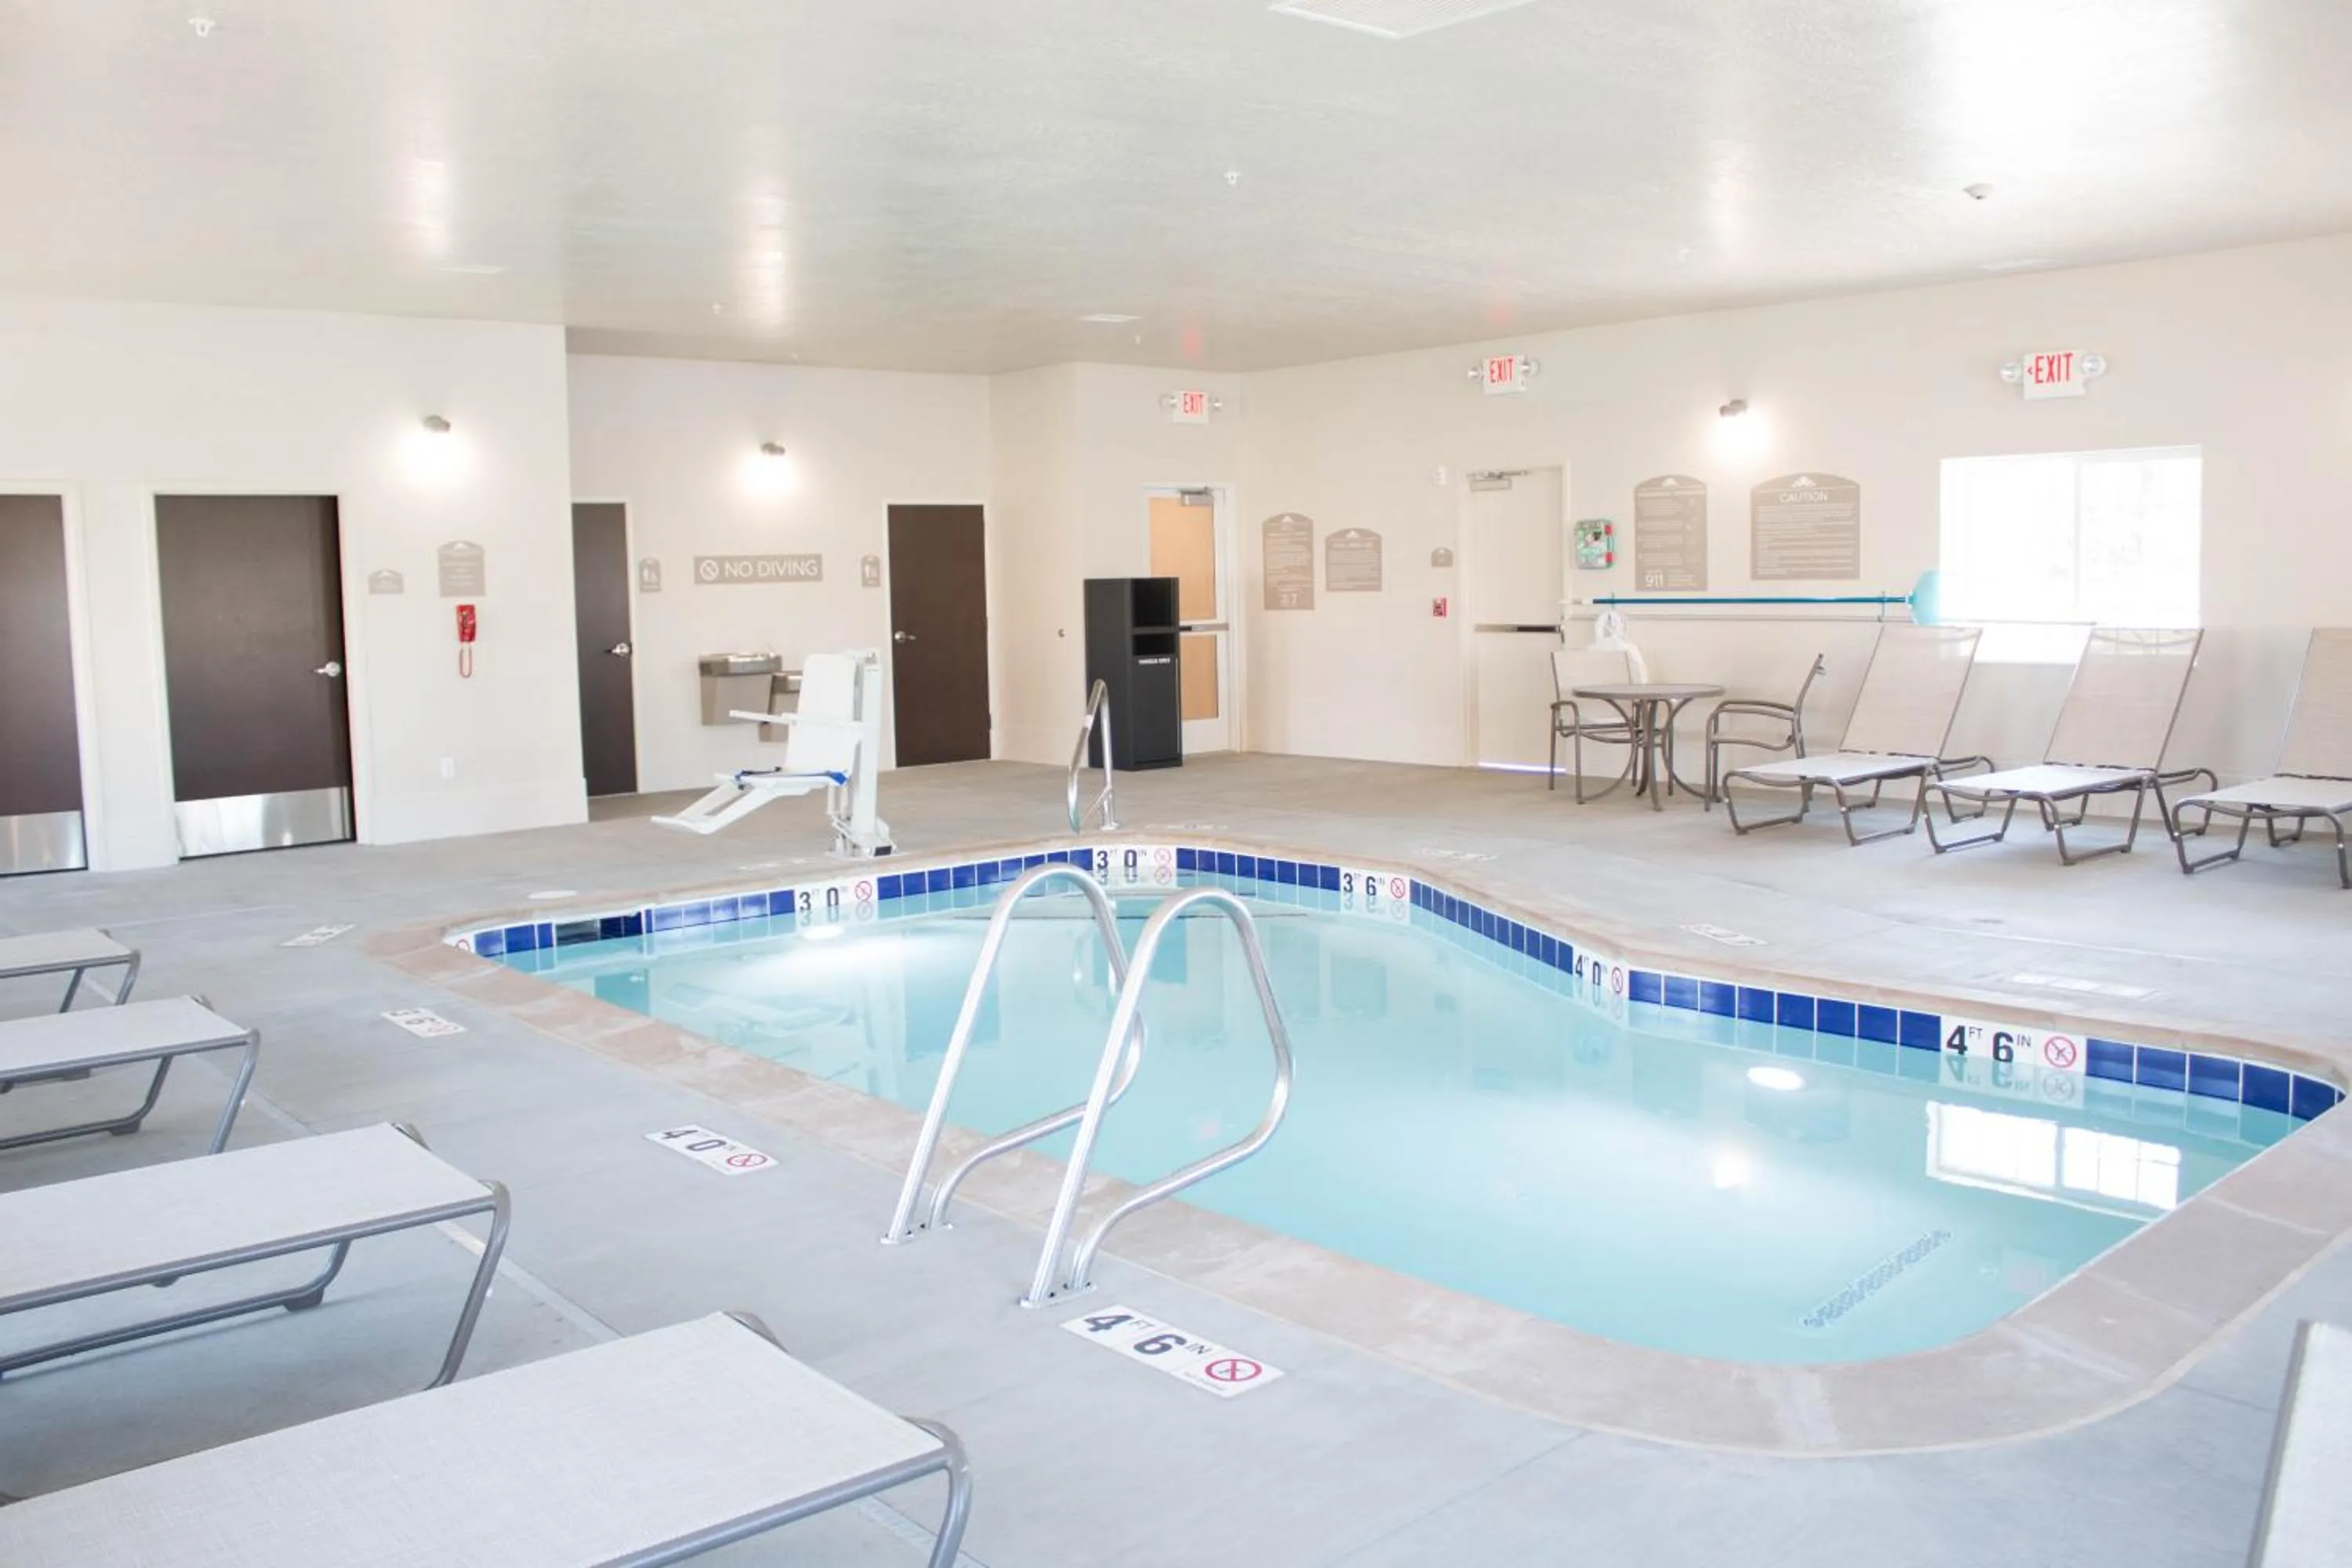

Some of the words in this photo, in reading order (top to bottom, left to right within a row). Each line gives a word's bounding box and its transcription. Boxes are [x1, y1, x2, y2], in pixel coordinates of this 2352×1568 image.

[1490, 358, 1514, 383] EXIT
[2035, 352, 2074, 384] EXIT
[1183, 393, 1203, 414] EXIT
[724, 561, 753, 578] NO
[758, 558, 818, 578] DIVING
[1646, 574, 1663, 588] 911
[1097, 851, 1108, 868] 3
[1123, 850, 1137, 867] 0
[1343, 873, 1353, 893] 3
[1367, 876, 1377, 896] 6
[800, 891, 811, 912] 3
[826, 887, 839, 907] 0
[1575, 954, 1583, 978] 4
[1592, 961, 1601, 986] 0
[1947, 1025, 1969, 1054] 4
[1969, 1026, 1984, 1040] FT
[1992, 1032, 2014, 1063] 6
[2016, 1034, 2032, 1047] IN
[662, 1130, 698, 1139] 4
[685, 1139, 728, 1151] 0
[1083, 1315, 1135, 1333] 4
[1133, 1334, 1188, 1356] 6
